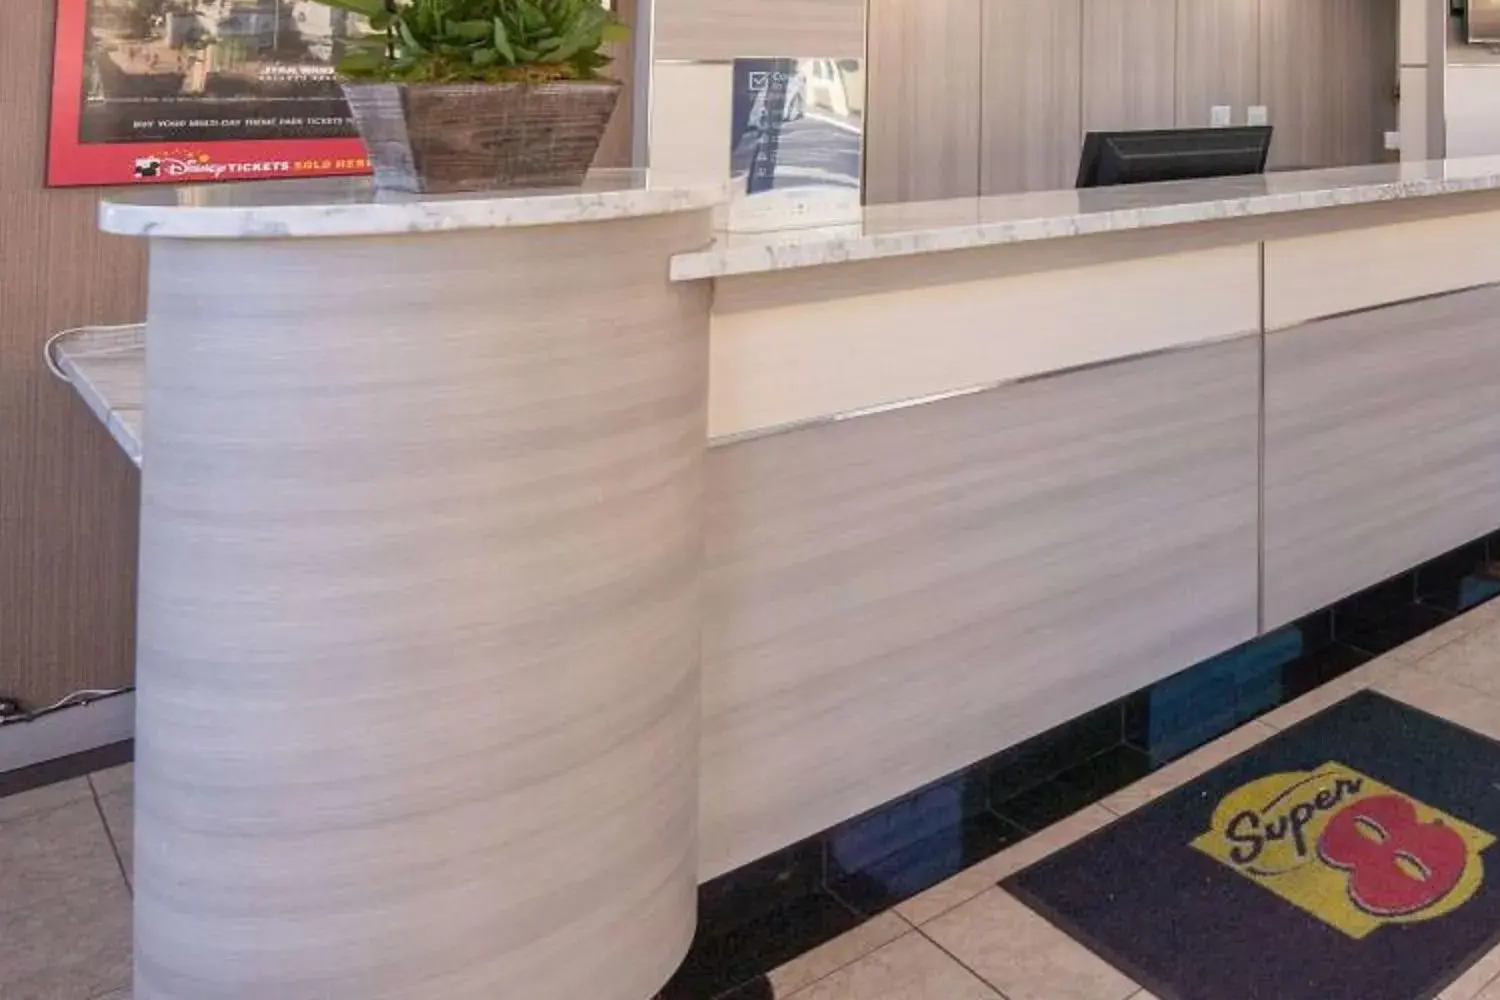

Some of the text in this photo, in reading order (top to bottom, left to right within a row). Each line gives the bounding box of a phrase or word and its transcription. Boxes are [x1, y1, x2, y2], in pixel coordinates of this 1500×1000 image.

[227, 161, 289, 172] TICKETS
[1224, 777, 1469, 917] Super 8
